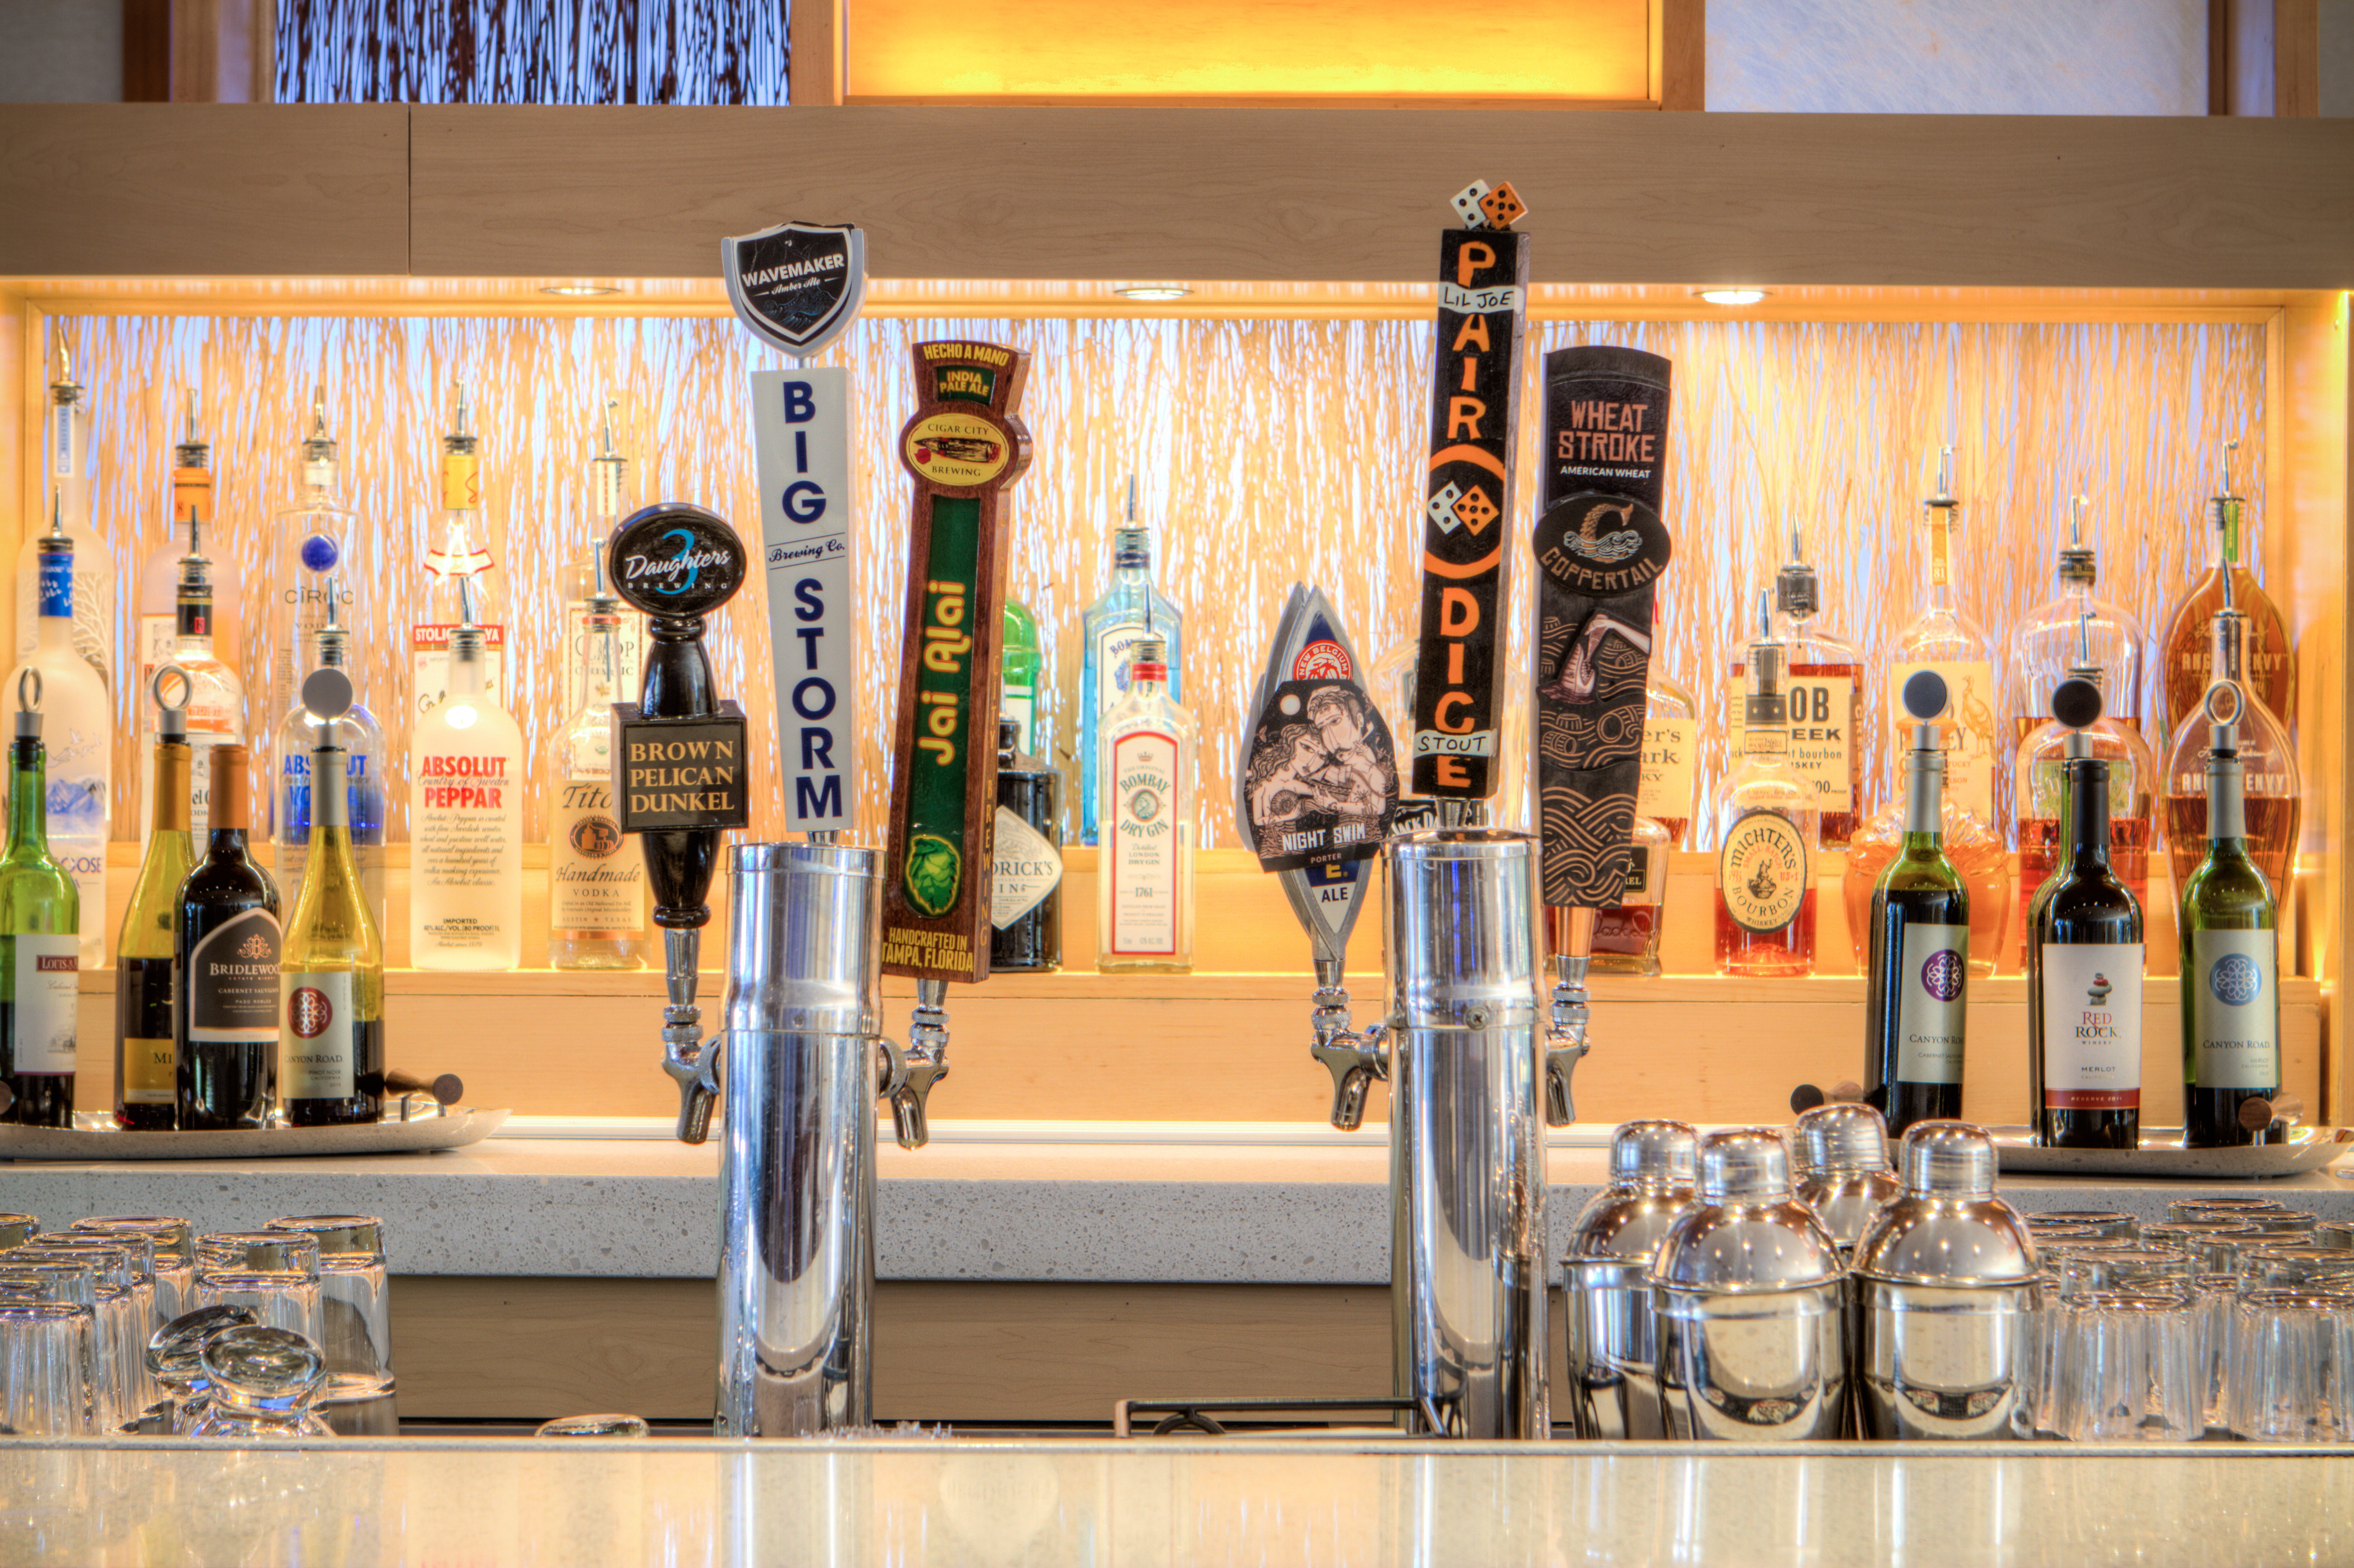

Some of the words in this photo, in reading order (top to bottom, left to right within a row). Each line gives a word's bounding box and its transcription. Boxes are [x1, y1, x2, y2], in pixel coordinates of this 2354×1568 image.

[741, 253, 845, 288] WAVEMAKER
[771, 282, 802, 295] Amber
[803, 276, 821, 289] Ale
[1477, 291, 1514, 309] JOE
[923, 343, 963, 360] HECHO
[964, 344, 972, 359] A
[973, 345, 1010, 367] MANO
[947, 370, 982, 385] INDIA
[939, 381, 967, 394] PALE
[968, 382, 990, 397] ALE
[1571, 400, 1648, 433] WHEAT
[928, 423, 961, 433] CIGAR
[964, 426, 989, 435] CITY
[782, 381, 827, 524] BIG
[1558, 430, 1655, 462] STROKE
[932, 465, 981, 477] BREWING
[1560, 465, 1614, 477] AMERICAN
[1615, 468, 1651, 479] WHEAT
[769, 544, 824, 562] Brewing
[826, 539, 845, 552] Co.
[625, 549, 731, 582] Daughters
[1540, 546, 1663, 590] COPPERTAIL
[415, 627, 500, 641] STOLICYA
[923, 580, 972, 673] Alai
[1299, 653, 1311, 676] NEW
[1313, 645, 1349, 672] BELGIUM
[792, 578, 843, 819] STORM
[1790, 686, 1829, 723] OB
[918, 690, 958, 766] Jai
[1643, 729, 1681, 743] er's
[1792, 728, 1841, 743] EEK
[630, 740, 734, 762] BROWN
[1418, 736, 1487, 752] STOUT
[1799, 747, 1842, 759] bourbon
[284, 755, 367, 776] ABSUT
[1641, 748, 1679, 764] ark
[421, 756, 506, 777] ABSOLUT
[1123, 766, 1135, 774] THE
[1136, 764, 1165, 774] ORIGINAL
[416, 770, 454, 791] Country
[470, 775, 509, 786] Sweden
[630, 766, 734, 787] PELICAN
[1119, 773, 1171, 794] BOMBAY
[2245, 773, 2284, 791] ENVY
[424, 787, 502, 809] PEPPAR
[630, 792, 735, 813] DUNKEL
[577, 817, 593, 826] AWARD
[595, 817, 616, 826] WINNING
[1120, 819, 1145, 838] DRY
[1146, 819, 1169, 837] GIN
[1282, 829, 1326, 851] NIGHT
[1333, 822, 1366, 844] SWIM
[575, 847, 597, 857] DISTILLED
[1730, 827, 1796, 869] MICHTER'S
[1743, 845, 1762, 868] SMALL
[1765, 846, 1782, 869] BATCH
[61, 857, 102, 873] OOSE
[1310, 853, 1342, 864] PORTER
[556, 862, 640, 882] Handmade
[993, 861, 1053, 876] DRICK'S
[573, 888, 619, 897] VODKA
[999, 883, 1018, 893] IN
[1135, 887, 1153, 897] 1761
[1321, 886, 1349, 903] ALE
[1732, 886, 1794, 916] BOURBON
[1746, 915, 1777, 925] WHISKEY
[889, 927, 956, 950] HANDCRAFTED
[957, 934, 967, 952] IN
[882, 942, 922, 968] TAMPA,
[924, 947, 973, 972] FLORIDA
[2082, 1011, 2113, 1029] RED
[1909, 1034, 1949, 1044] CANYON
[2203, 1040, 2244, 1049] CANYON
[284, 1055, 312, 1063] CANYON
